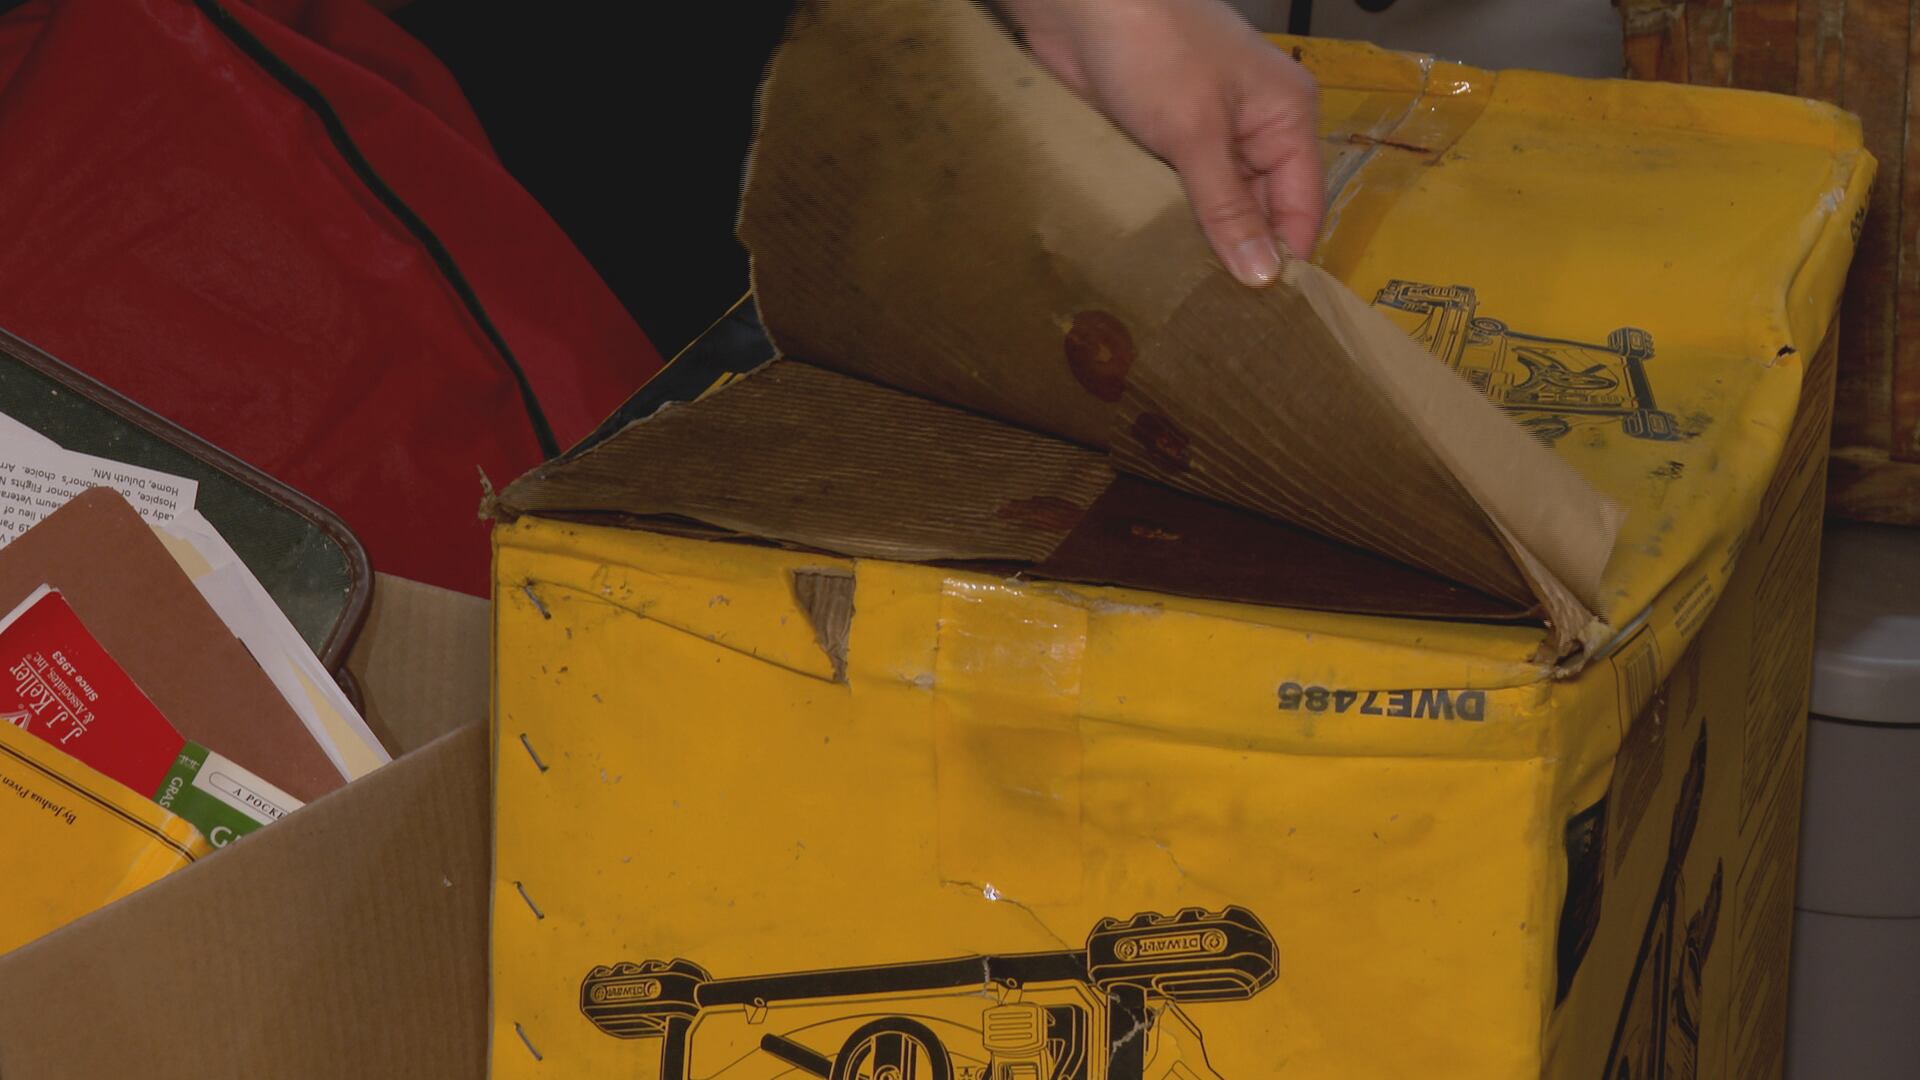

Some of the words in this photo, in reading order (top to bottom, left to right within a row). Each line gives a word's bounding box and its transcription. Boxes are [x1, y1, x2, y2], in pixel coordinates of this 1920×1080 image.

[22, 466, 56, 481] choice.
[91, 467, 112, 481] MN.
[114, 473, 146, 489] Duluth
[11, 477, 43, 493] Flights
[149, 480, 179, 497] Home,
[137, 490, 177, 510] Hospice,
[3, 505, 15, 514] of
[18, 508, 36, 520] lieu
[52, 650, 76, 677] 1953
[9, 661, 55, 715] Keller
[48, 667, 88, 715] Associates,
[75, 675, 99, 702] Since
[1278, 681, 1486, 722] DWE7485
[46, 705, 69, 728] J.
[82, 711, 95, 725] &
[60, 720, 83, 744] J.
[3, 776, 31, 799] Piven
[232, 787, 242, 797] A
[31, 793, 66, 816] Joshua
[62, 810, 77, 826] By
[209, 825, 242, 848] G
[1141, 937, 1200, 953] DEWALT
